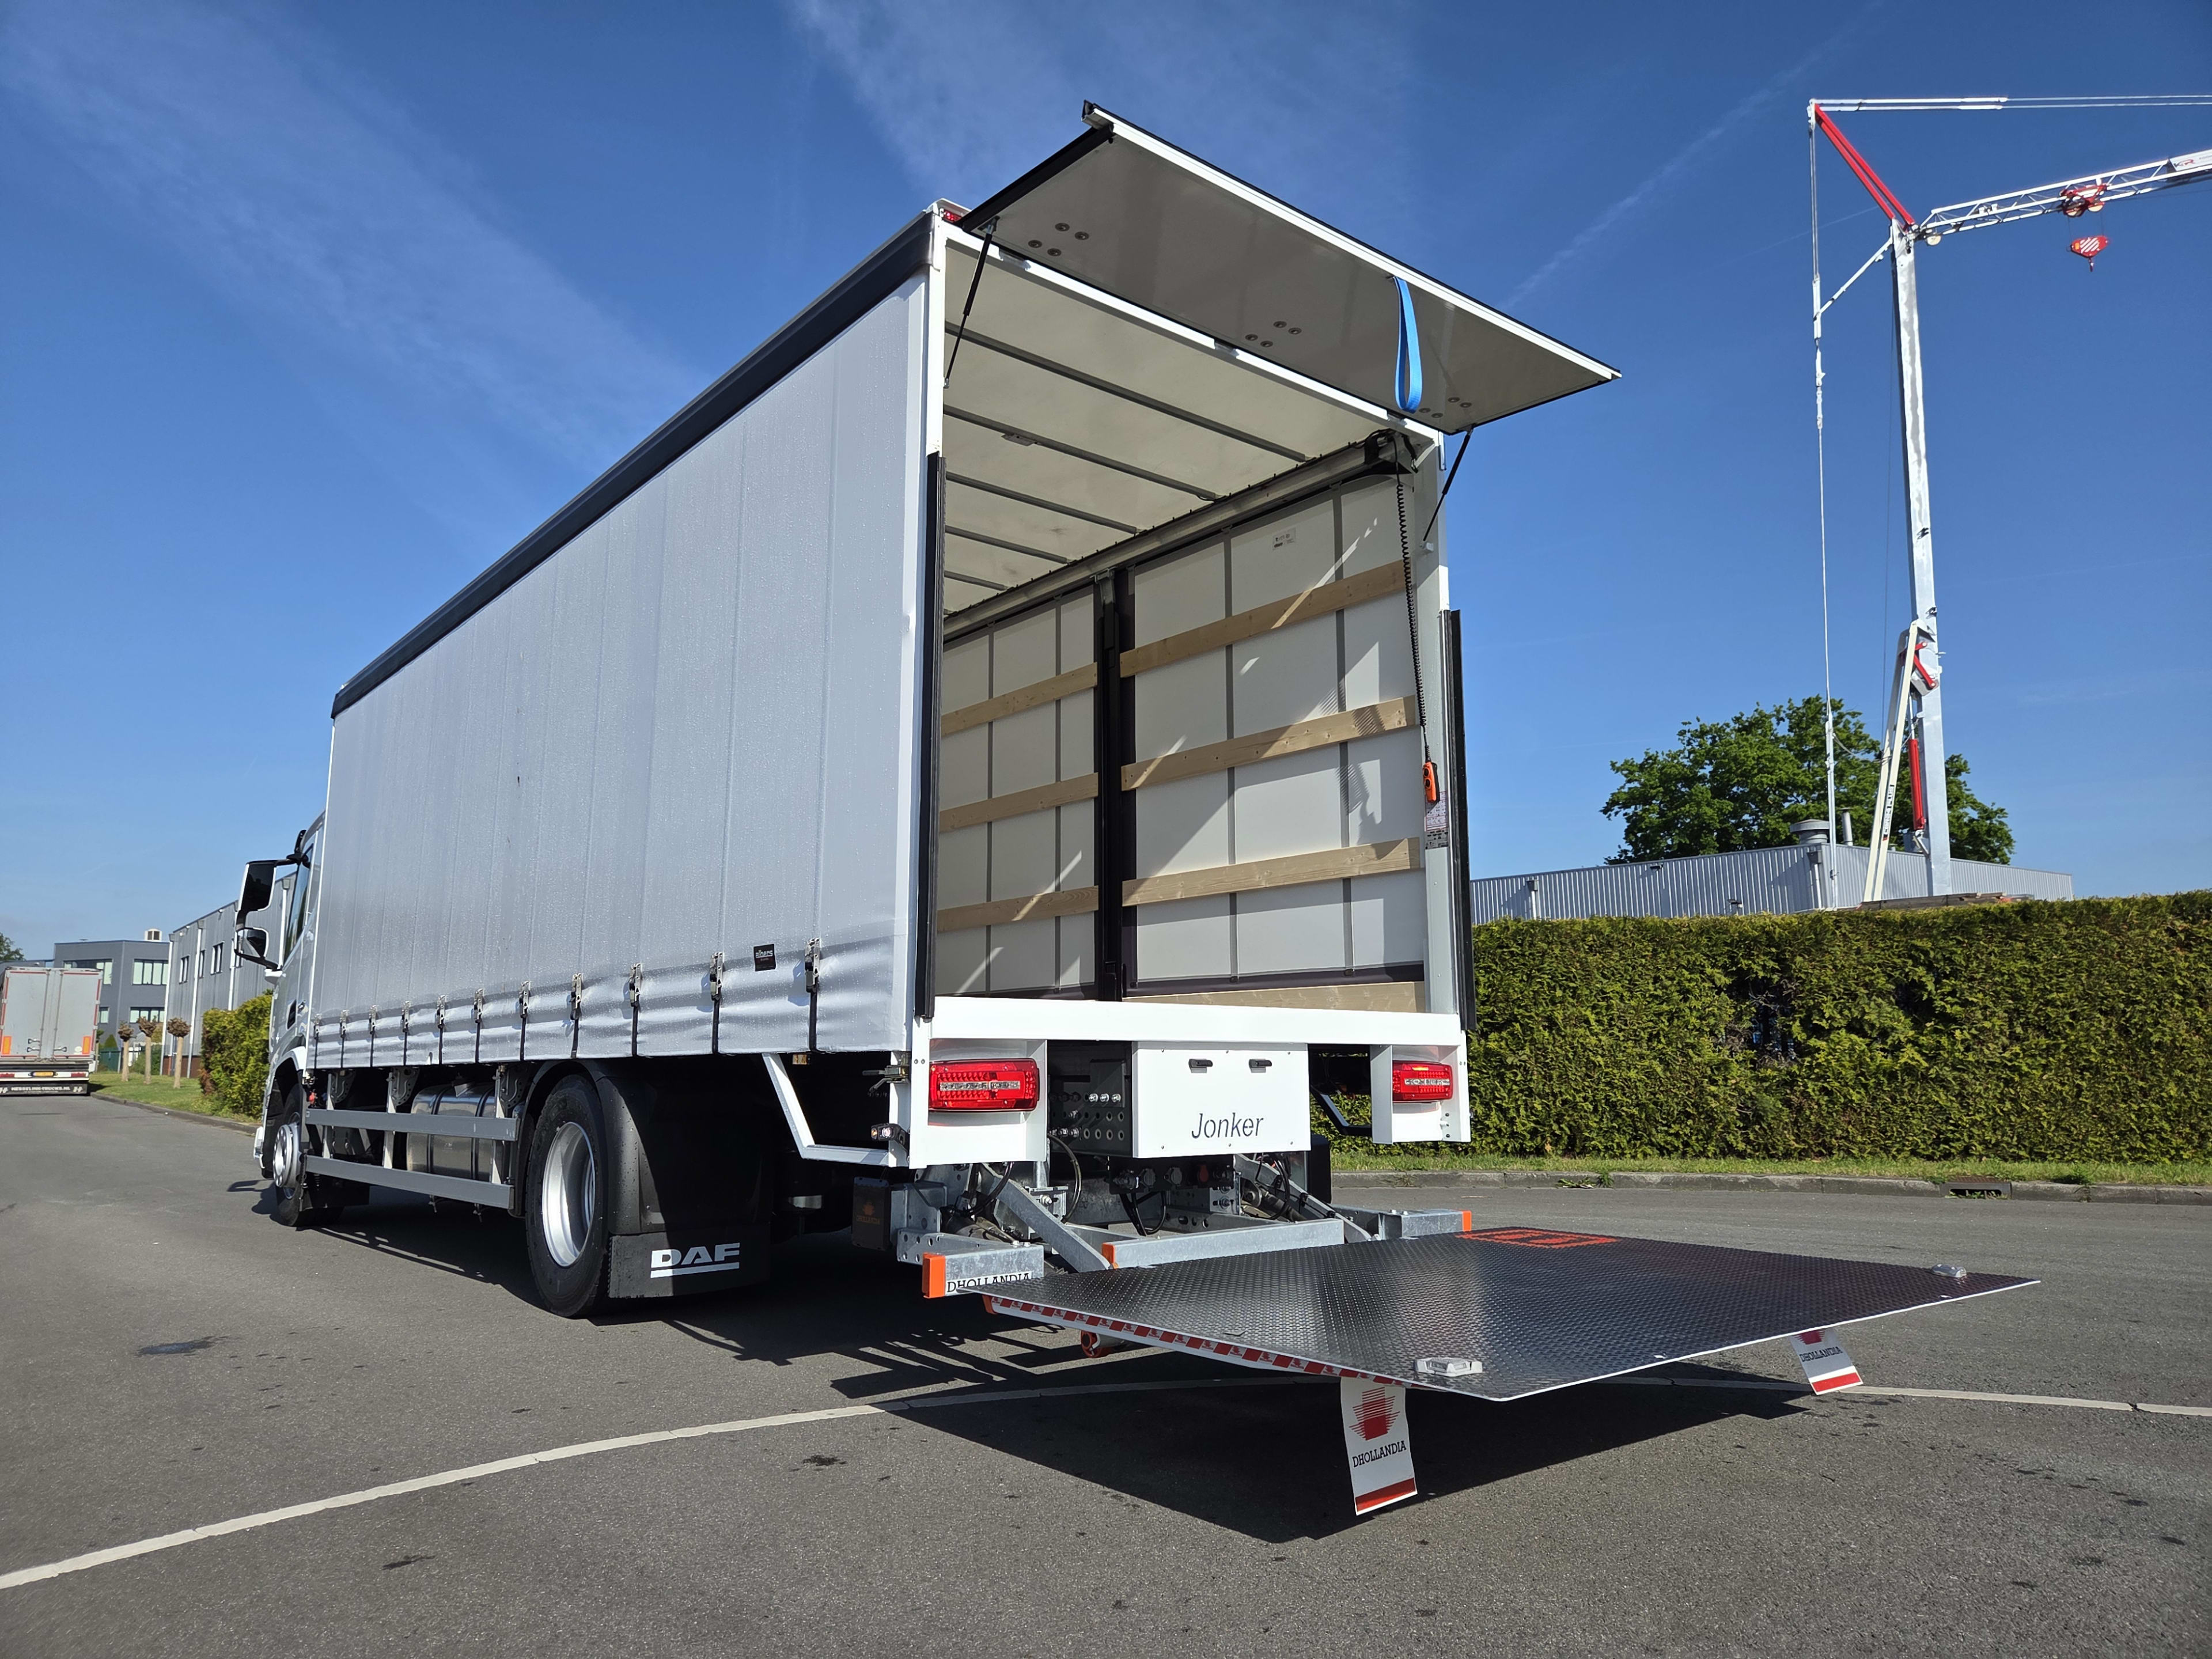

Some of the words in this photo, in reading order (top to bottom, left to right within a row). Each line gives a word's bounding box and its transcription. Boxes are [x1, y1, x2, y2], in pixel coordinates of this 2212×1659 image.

[1191, 1112, 1264, 1139] Jonker
[651, 1243, 740, 1268] DAF
[1351, 1440, 1407, 1468] DHOLLANDIA
